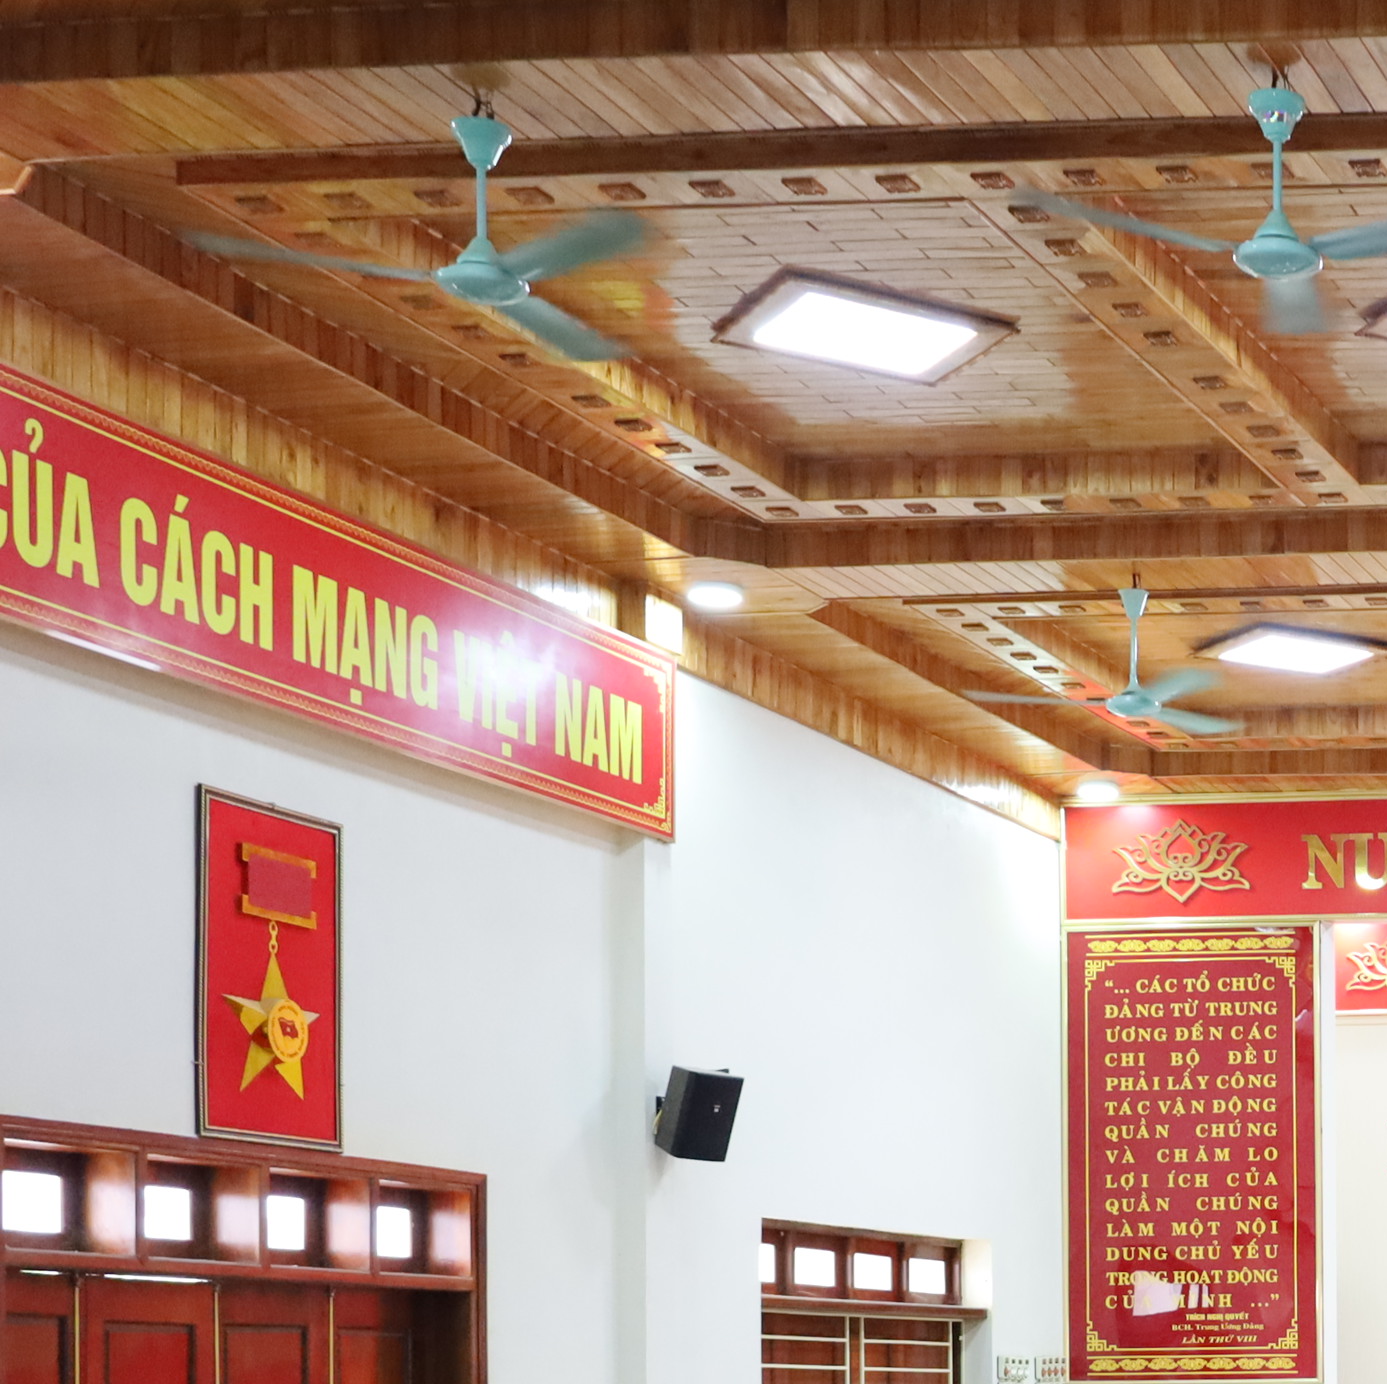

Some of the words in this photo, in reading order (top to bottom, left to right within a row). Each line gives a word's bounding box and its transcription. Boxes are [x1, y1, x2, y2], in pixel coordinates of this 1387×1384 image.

[0, 418, 100, 588] ỦA
[120, 495, 273, 651] CÁCH
[293, 567, 437, 708] MẠNG
[454, 630, 548, 759] VIỆT
[555, 673, 642, 785] NAM
[1136, 975, 1177, 993] CÁC
[1184, 971, 1210, 992] TỔ
[1218, 973, 1275, 991] CHỨC
[1105, 999, 1164, 1018] ĐẢNG
[1171, 999, 1199, 1017] TỪ
[1206, 1001, 1278, 1015] TRUNG
[1106, 1026, 1167, 1042] ƯƠNG
[1175, 1020, 1223, 1040] ĐẾN
[1231, 1022, 1277, 1039] CÁC
[1105, 1053, 1145, 1066] CHI
[1171, 1048, 1200, 1068] BỘ
[1228, 1043, 1277, 1064] ĐỀU
[1105, 1098, 1150, 1115] TÁC
[1158, 1097, 1205, 1116] VẬN
[1213, 1096, 1277, 1115] ĐỘNG
[1105, 1118, 1169, 1142] QUẦN
[1195, 1119, 1277, 1138] CHÚNG
[1106, 1220, 1154, 1237] LÀM
[1171, 1218, 1220, 1238] MỘT
[1236, 1217, 1278, 1237] NỘI
[1106, 1246, 1168, 1261] DUNG
[1175, 1241, 1221, 1260] CHỦ
[1232, 1239, 1278, 1259] YẾU
[1227, 1267, 1278, 1286] ĐỘNG
